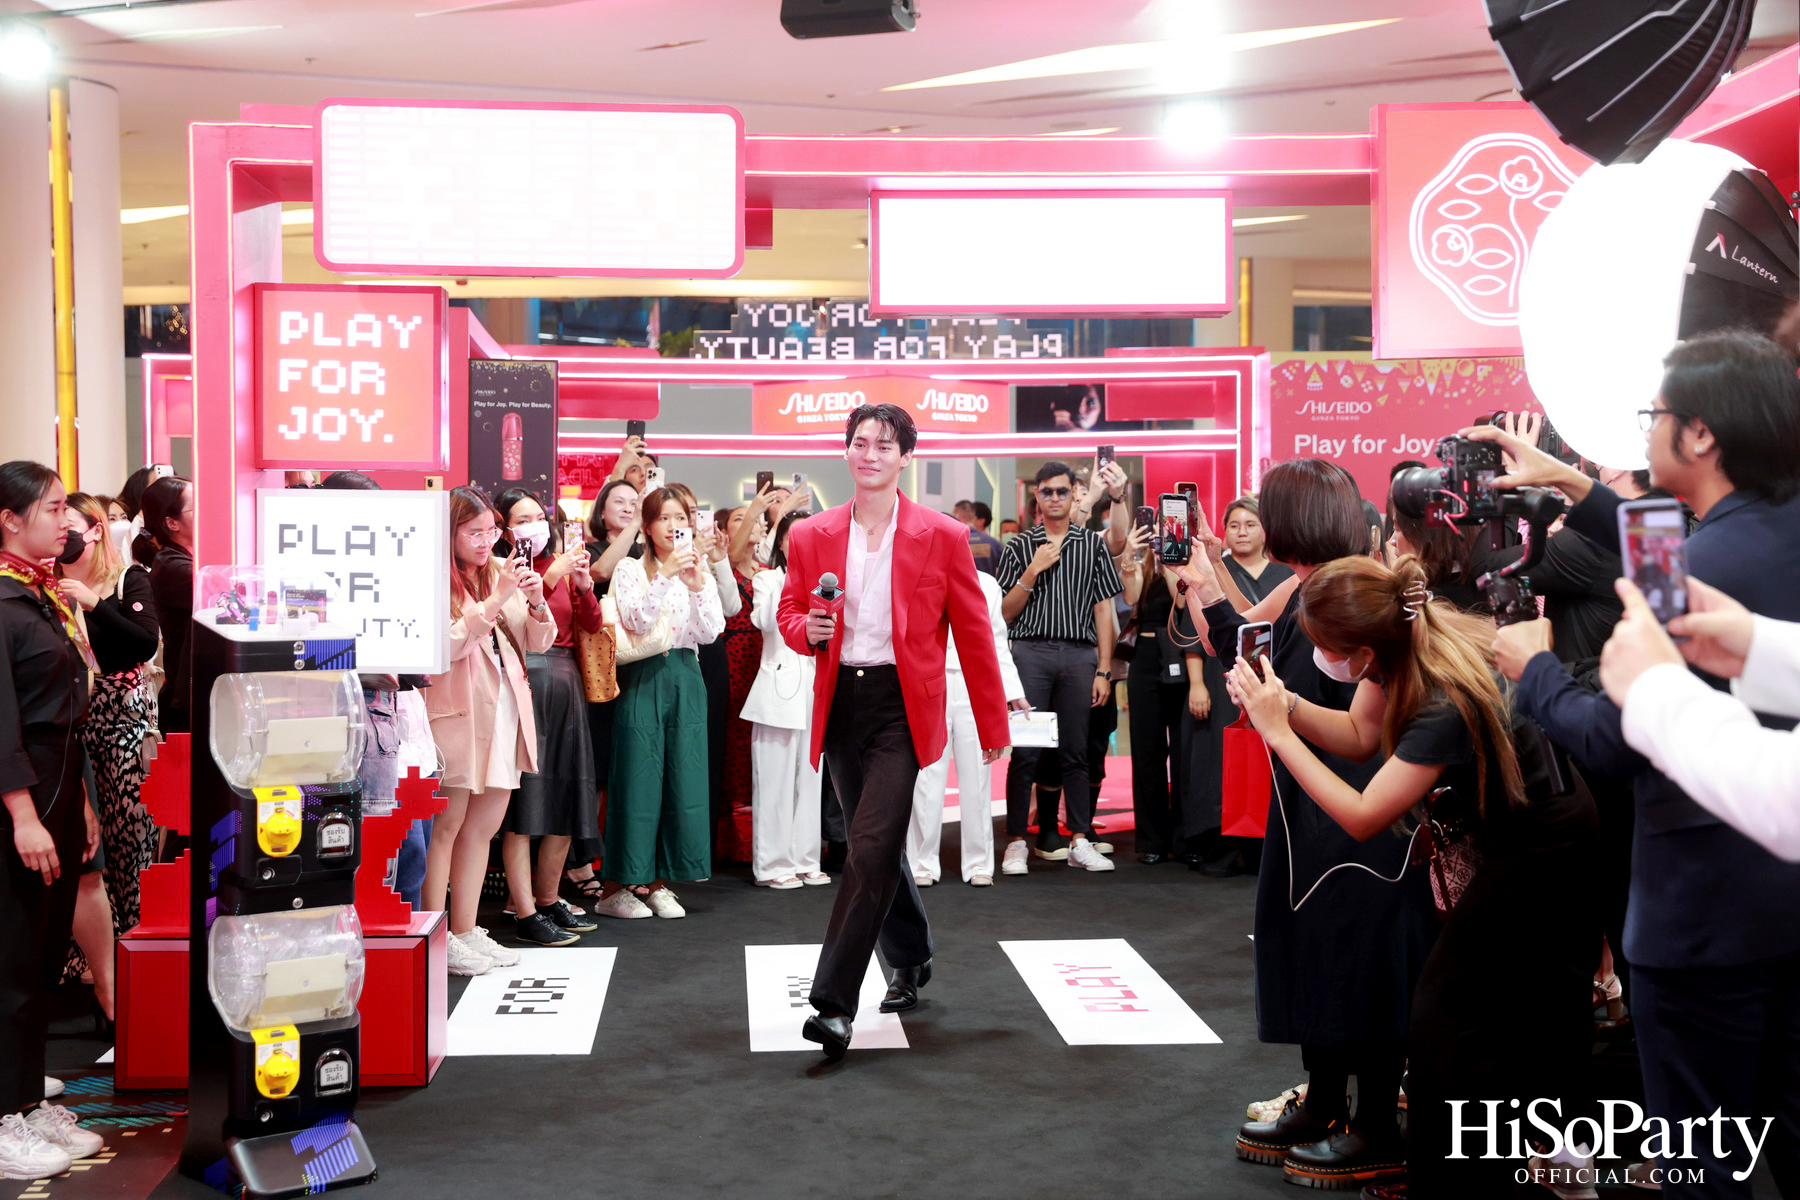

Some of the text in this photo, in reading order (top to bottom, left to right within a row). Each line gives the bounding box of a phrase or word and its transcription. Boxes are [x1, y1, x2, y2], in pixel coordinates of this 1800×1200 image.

[1731, 245, 1779, 284] Lantern
[279, 311, 422, 349] PLAY
[279, 358, 386, 395] FOR
[474, 400, 486, 408] Play
[778, 391, 866, 415] SHISEIDO
[916, 389, 989, 413] SHISEIDO
[1295, 400, 1372, 415] SHISEIDO
[278, 406, 393, 443] JOY.
[796, 413, 822, 424] GINZA
[931, 412, 977, 423] GINZA TOKYO
[1294, 434, 1435, 458] Play for Joy
[279, 524, 416, 556] PLAY
[495, 978, 570, 1015] FOR
[1053, 963, 1149, 1012] PLAY
